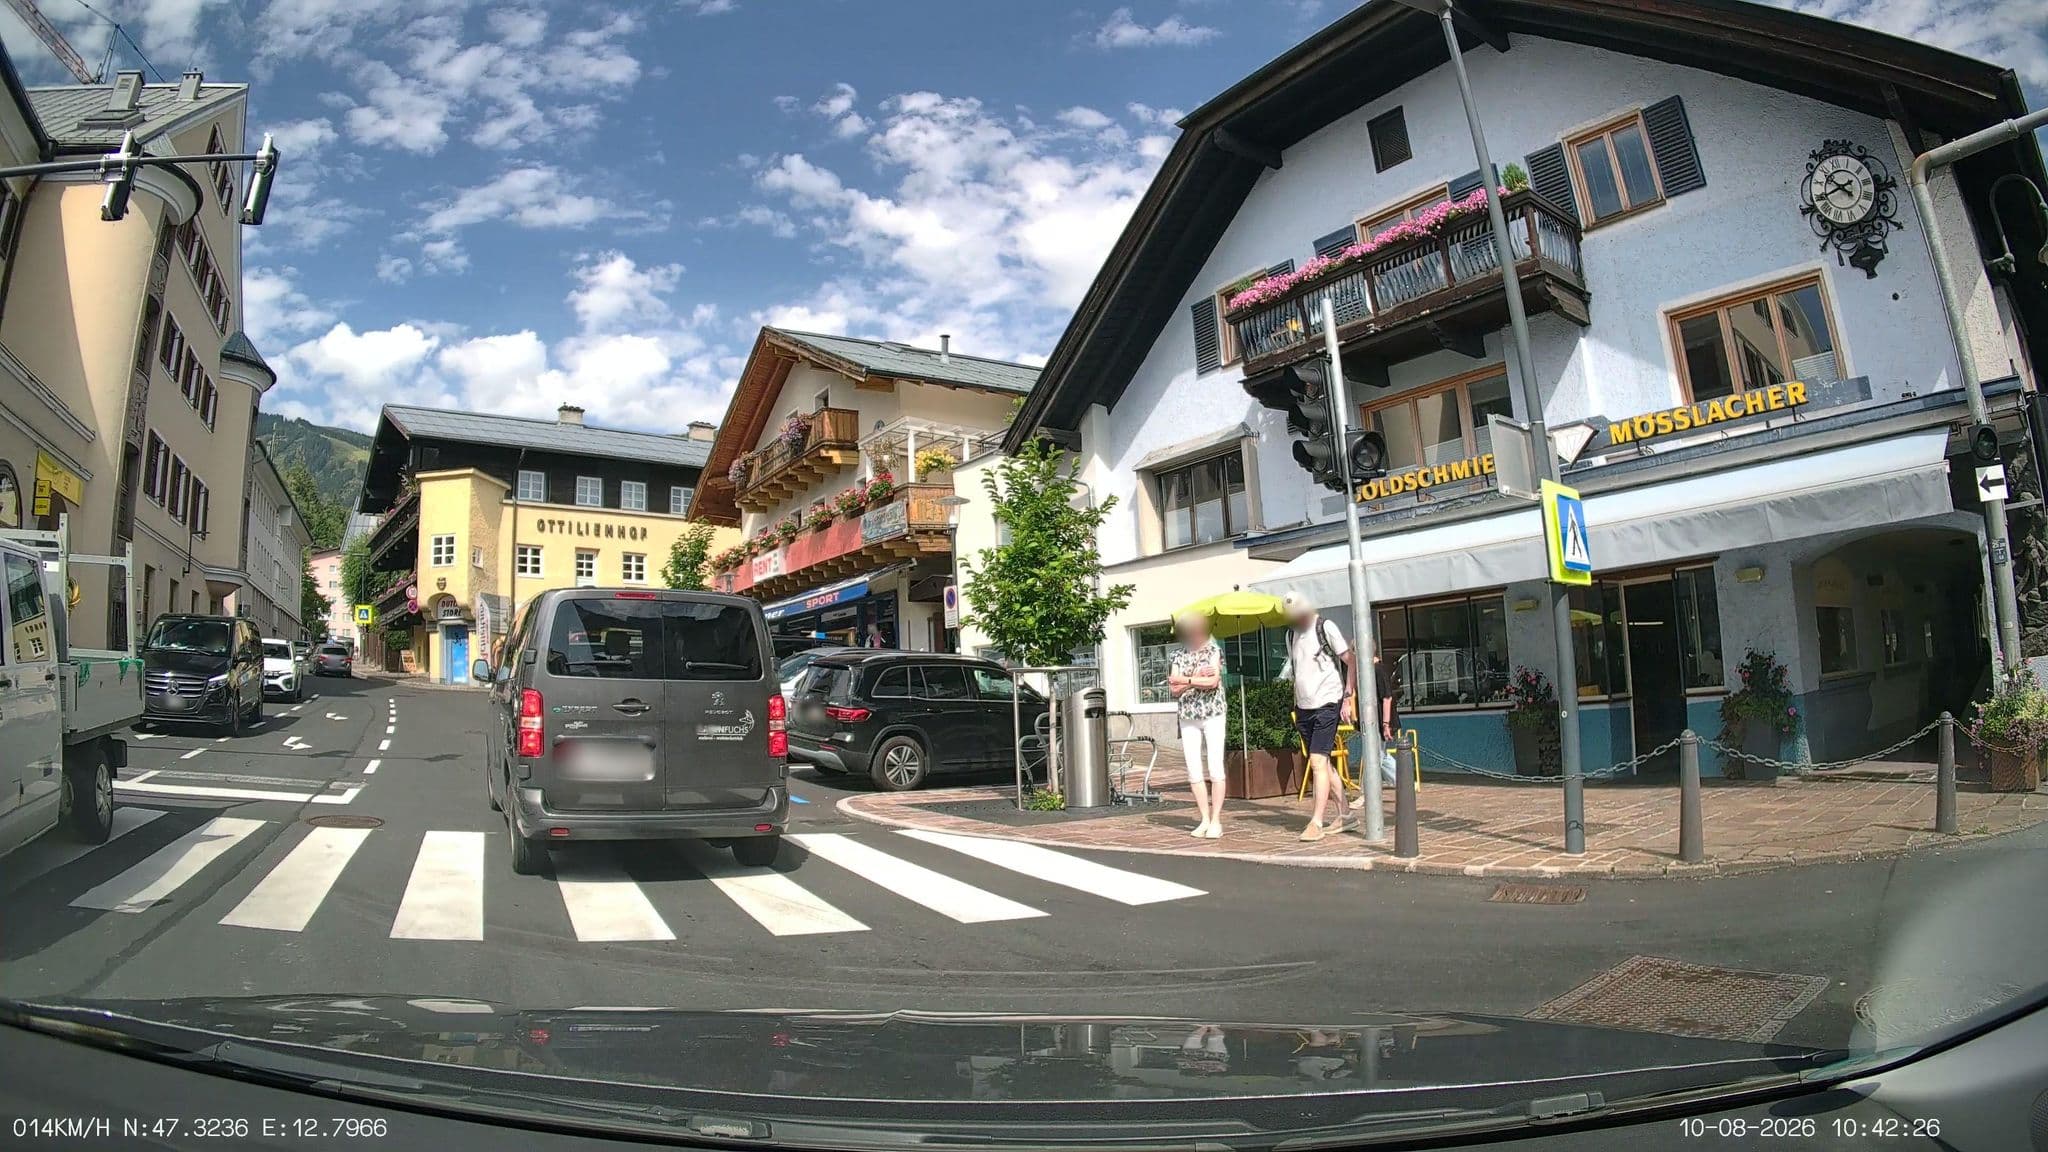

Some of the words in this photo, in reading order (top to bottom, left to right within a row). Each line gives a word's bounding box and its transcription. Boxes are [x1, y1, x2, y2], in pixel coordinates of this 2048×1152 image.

[1608, 381, 1809, 445] MÖSSLACHER
[536, 518, 648, 541] OTTILIENHOF
[441, 600, 458, 608] OUTL
[764, 609, 785, 619] ner
[805, 591, 840, 609] SPORT
